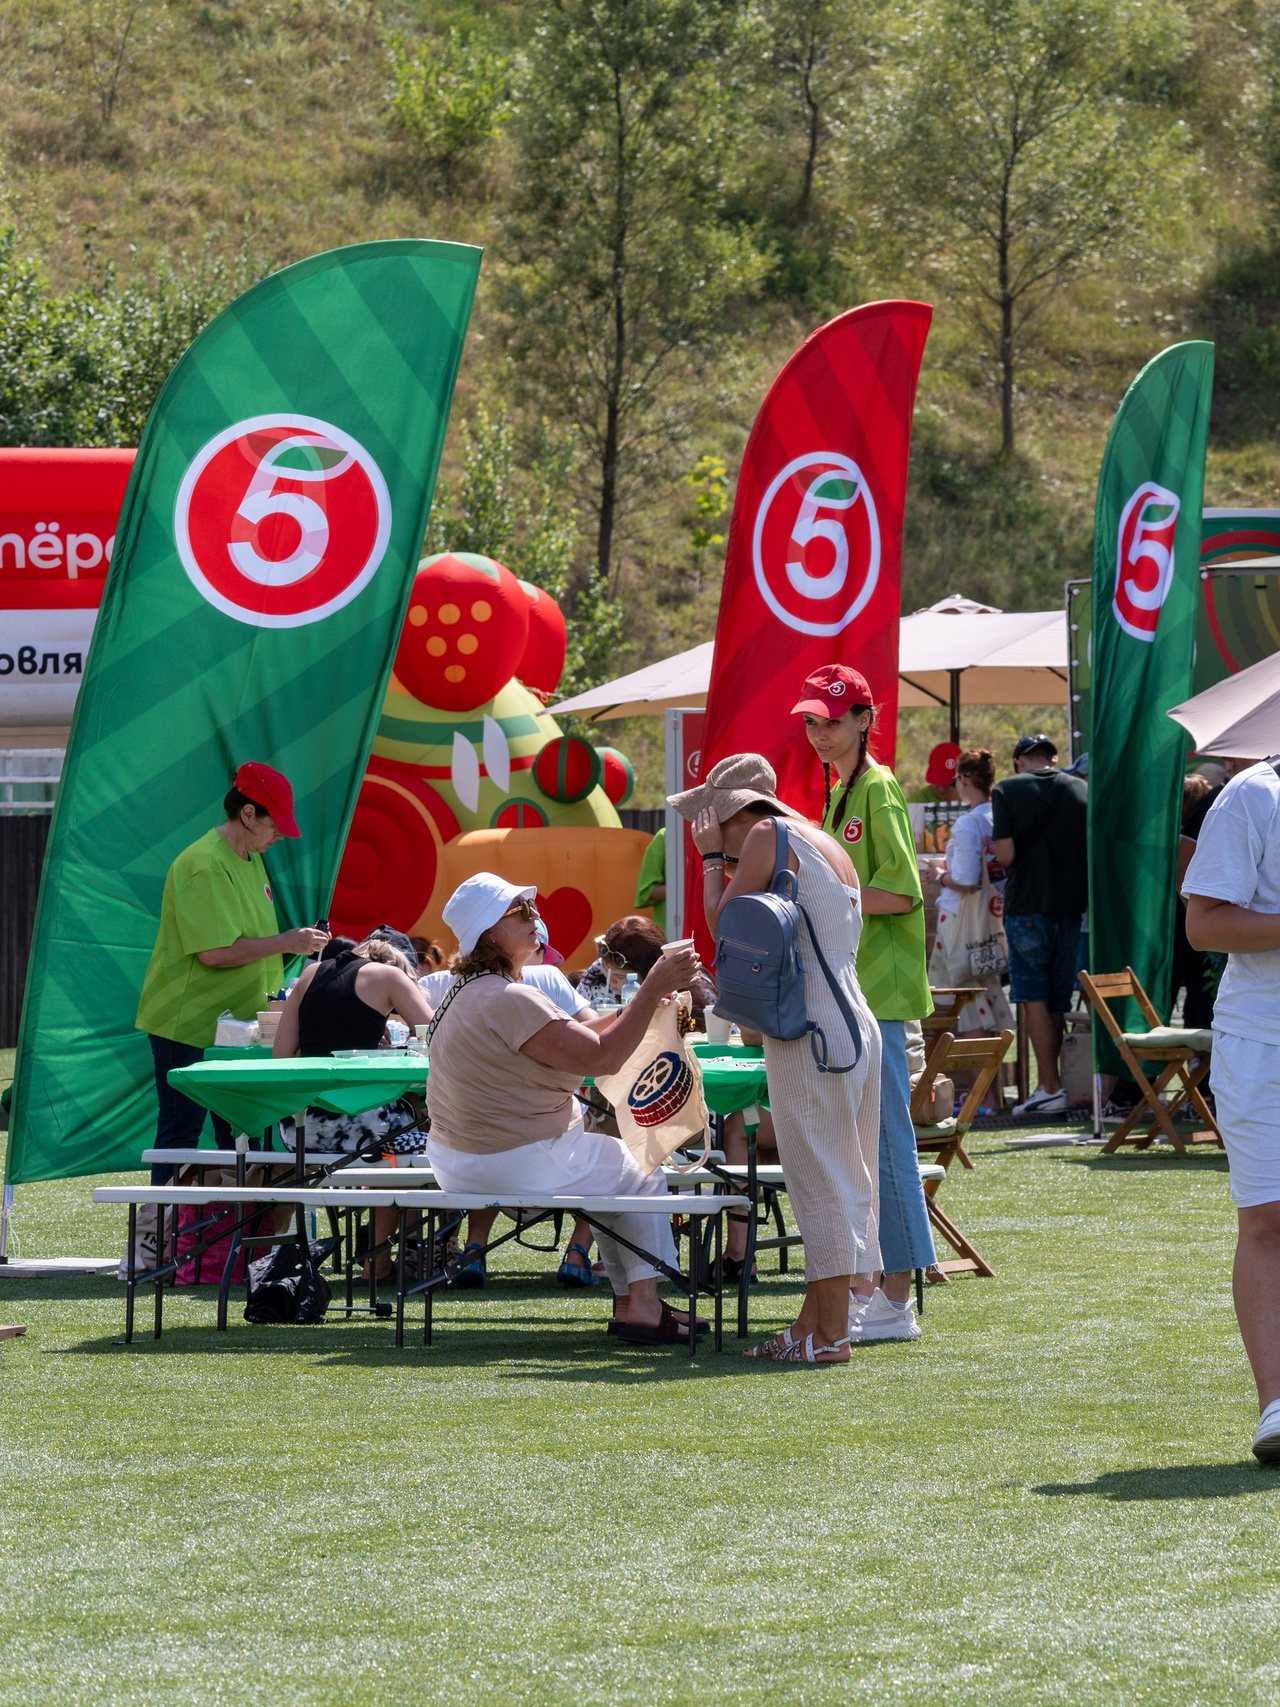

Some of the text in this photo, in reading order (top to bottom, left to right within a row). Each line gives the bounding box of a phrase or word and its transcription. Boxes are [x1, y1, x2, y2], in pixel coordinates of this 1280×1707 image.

[227, 436, 351, 586] 5
[785, 470, 858, 600] 5
[1124, 496, 1177, 611] 5
